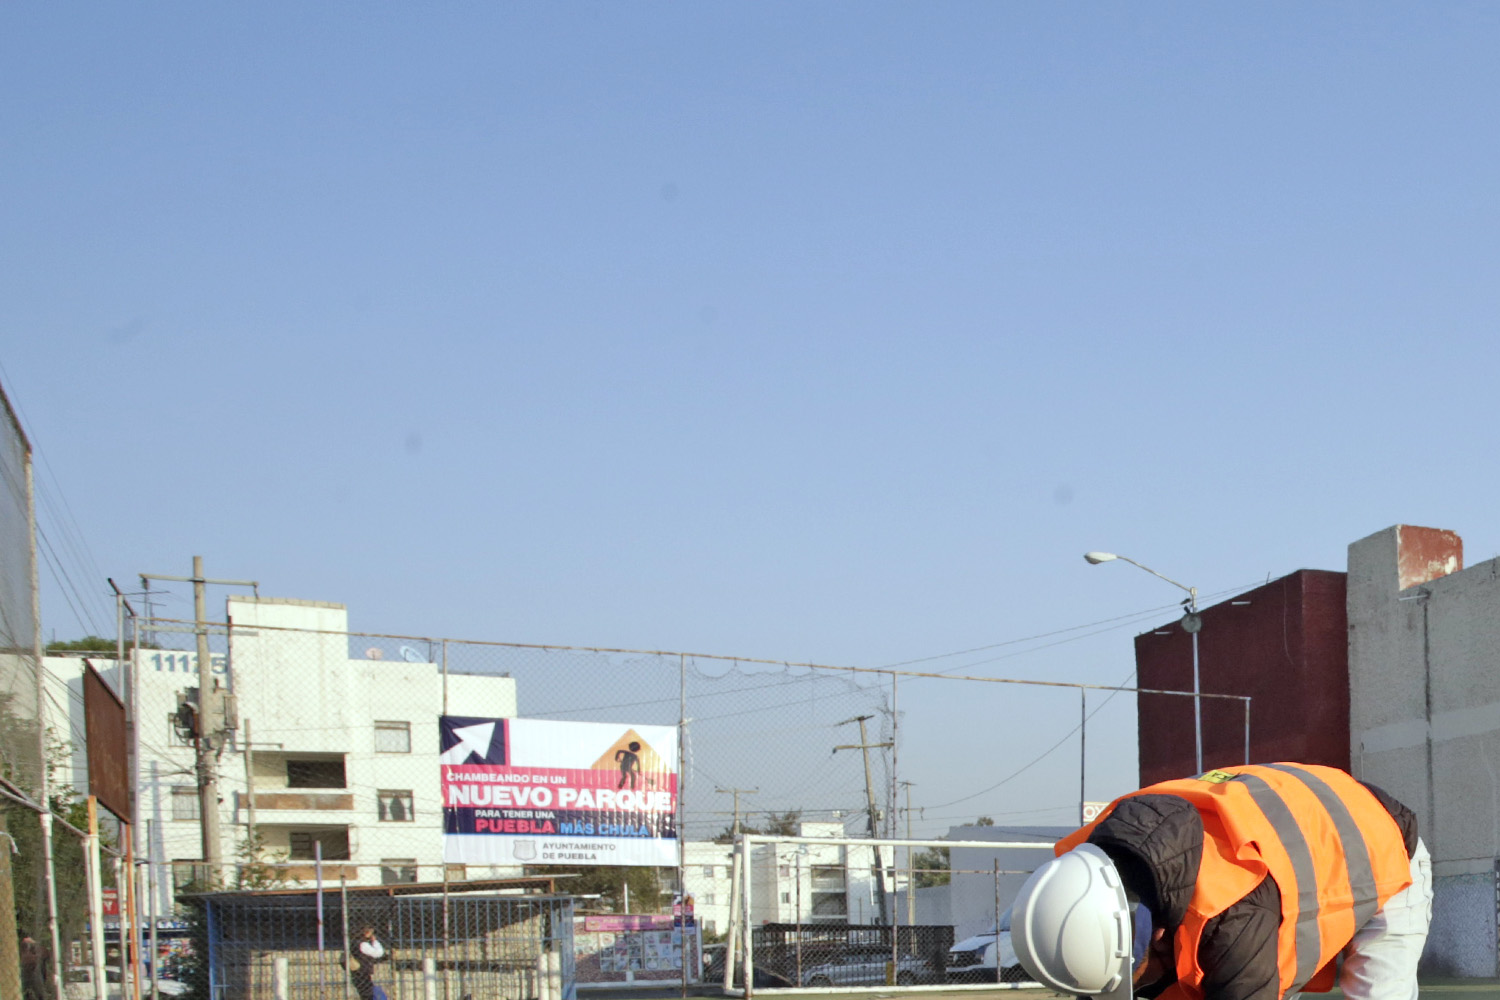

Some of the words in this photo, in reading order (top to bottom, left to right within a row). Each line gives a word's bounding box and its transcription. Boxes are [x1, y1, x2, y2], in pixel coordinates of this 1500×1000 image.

[446, 772, 530, 783] CHAMBEANDO
[532, 775, 548, 784] EN
[550, 776, 567, 784] UN
[448, 784, 553, 807] NUEVO
[558, 788, 671, 811] PARQUE
[475, 809, 500, 818] PARA
[502, 810, 534, 819] TENER
[535, 811, 555, 819] UNA
[475, 819, 556, 834] PUEBLA
[560, 820, 595, 834] MÁS
[598, 823, 649, 836] CHULA
[542, 842, 616, 851] AYUNTAMIENTO
[542, 852, 555, 860] DE
[558, 852, 597, 860] PUEBLA
